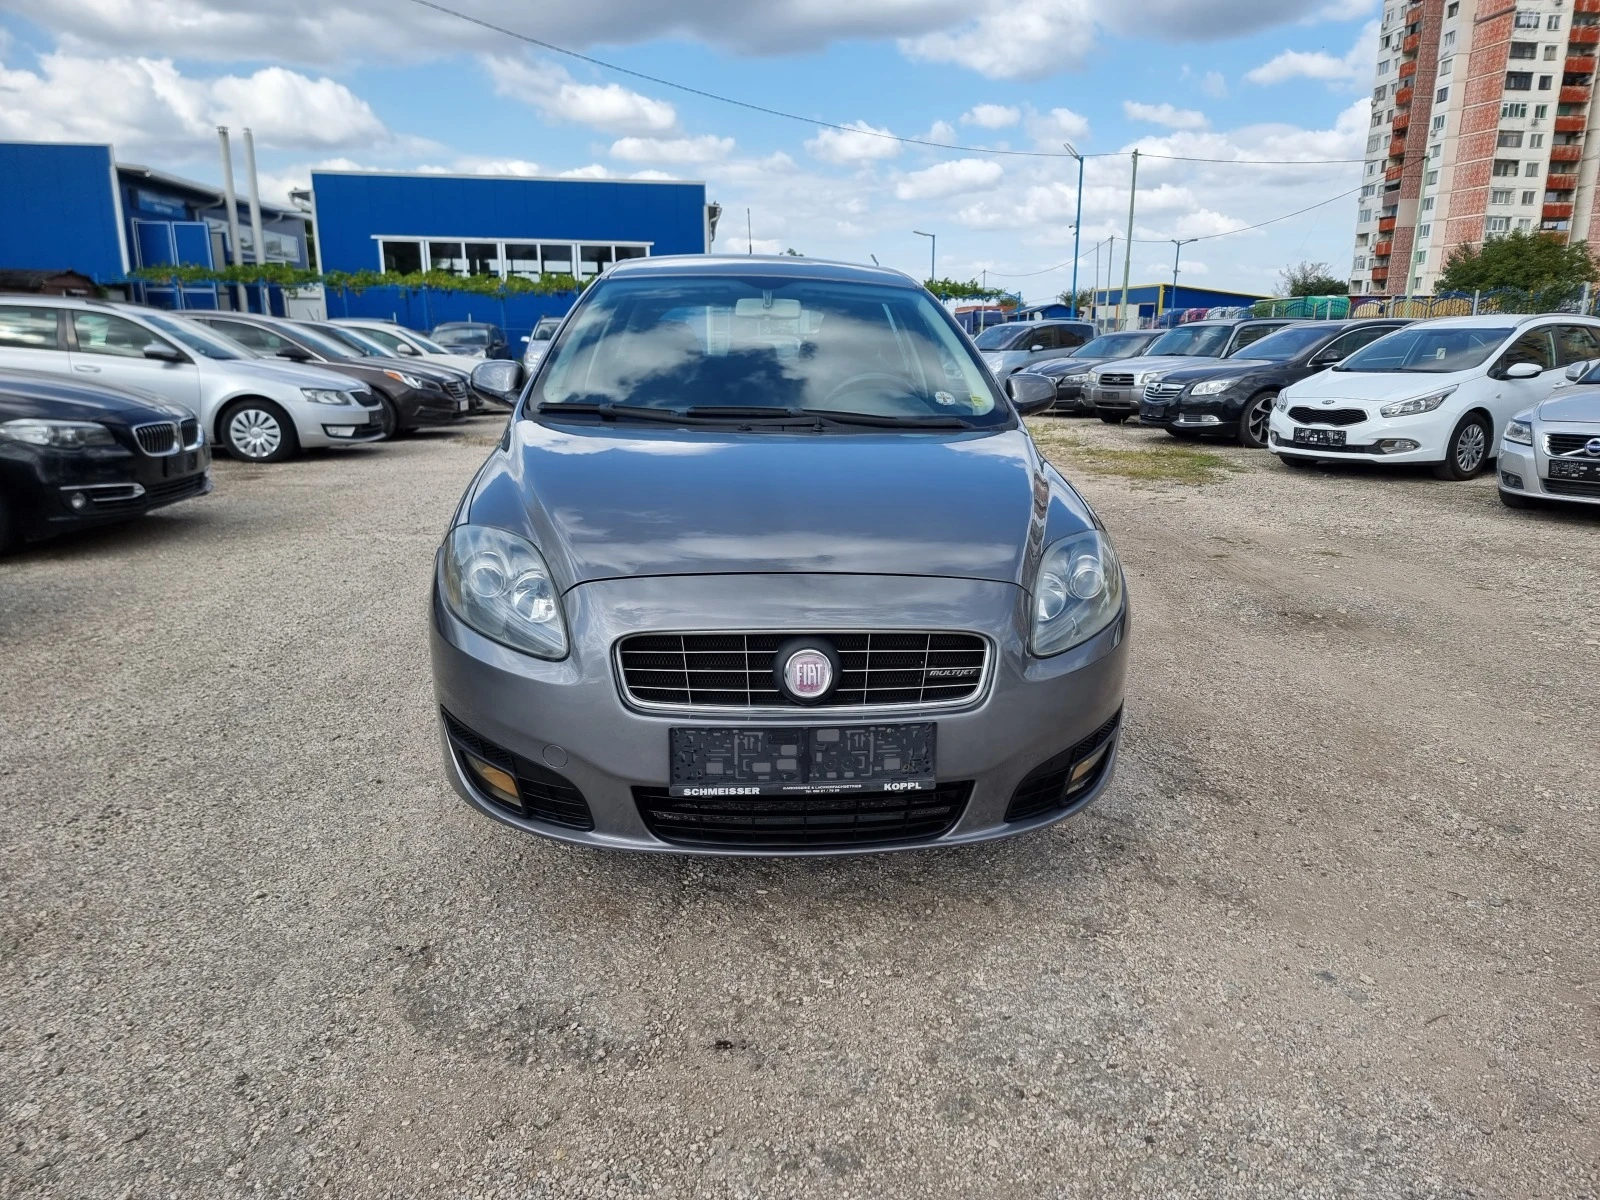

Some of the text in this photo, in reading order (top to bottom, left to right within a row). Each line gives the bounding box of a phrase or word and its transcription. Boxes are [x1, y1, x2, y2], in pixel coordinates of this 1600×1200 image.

[796, 663, 823, 685] FIAT
[930, 669, 977, 677] MULTIJET
[883, 782, 922, 791] KOPPL
[683, 787, 760, 796] SCHMEISSER
